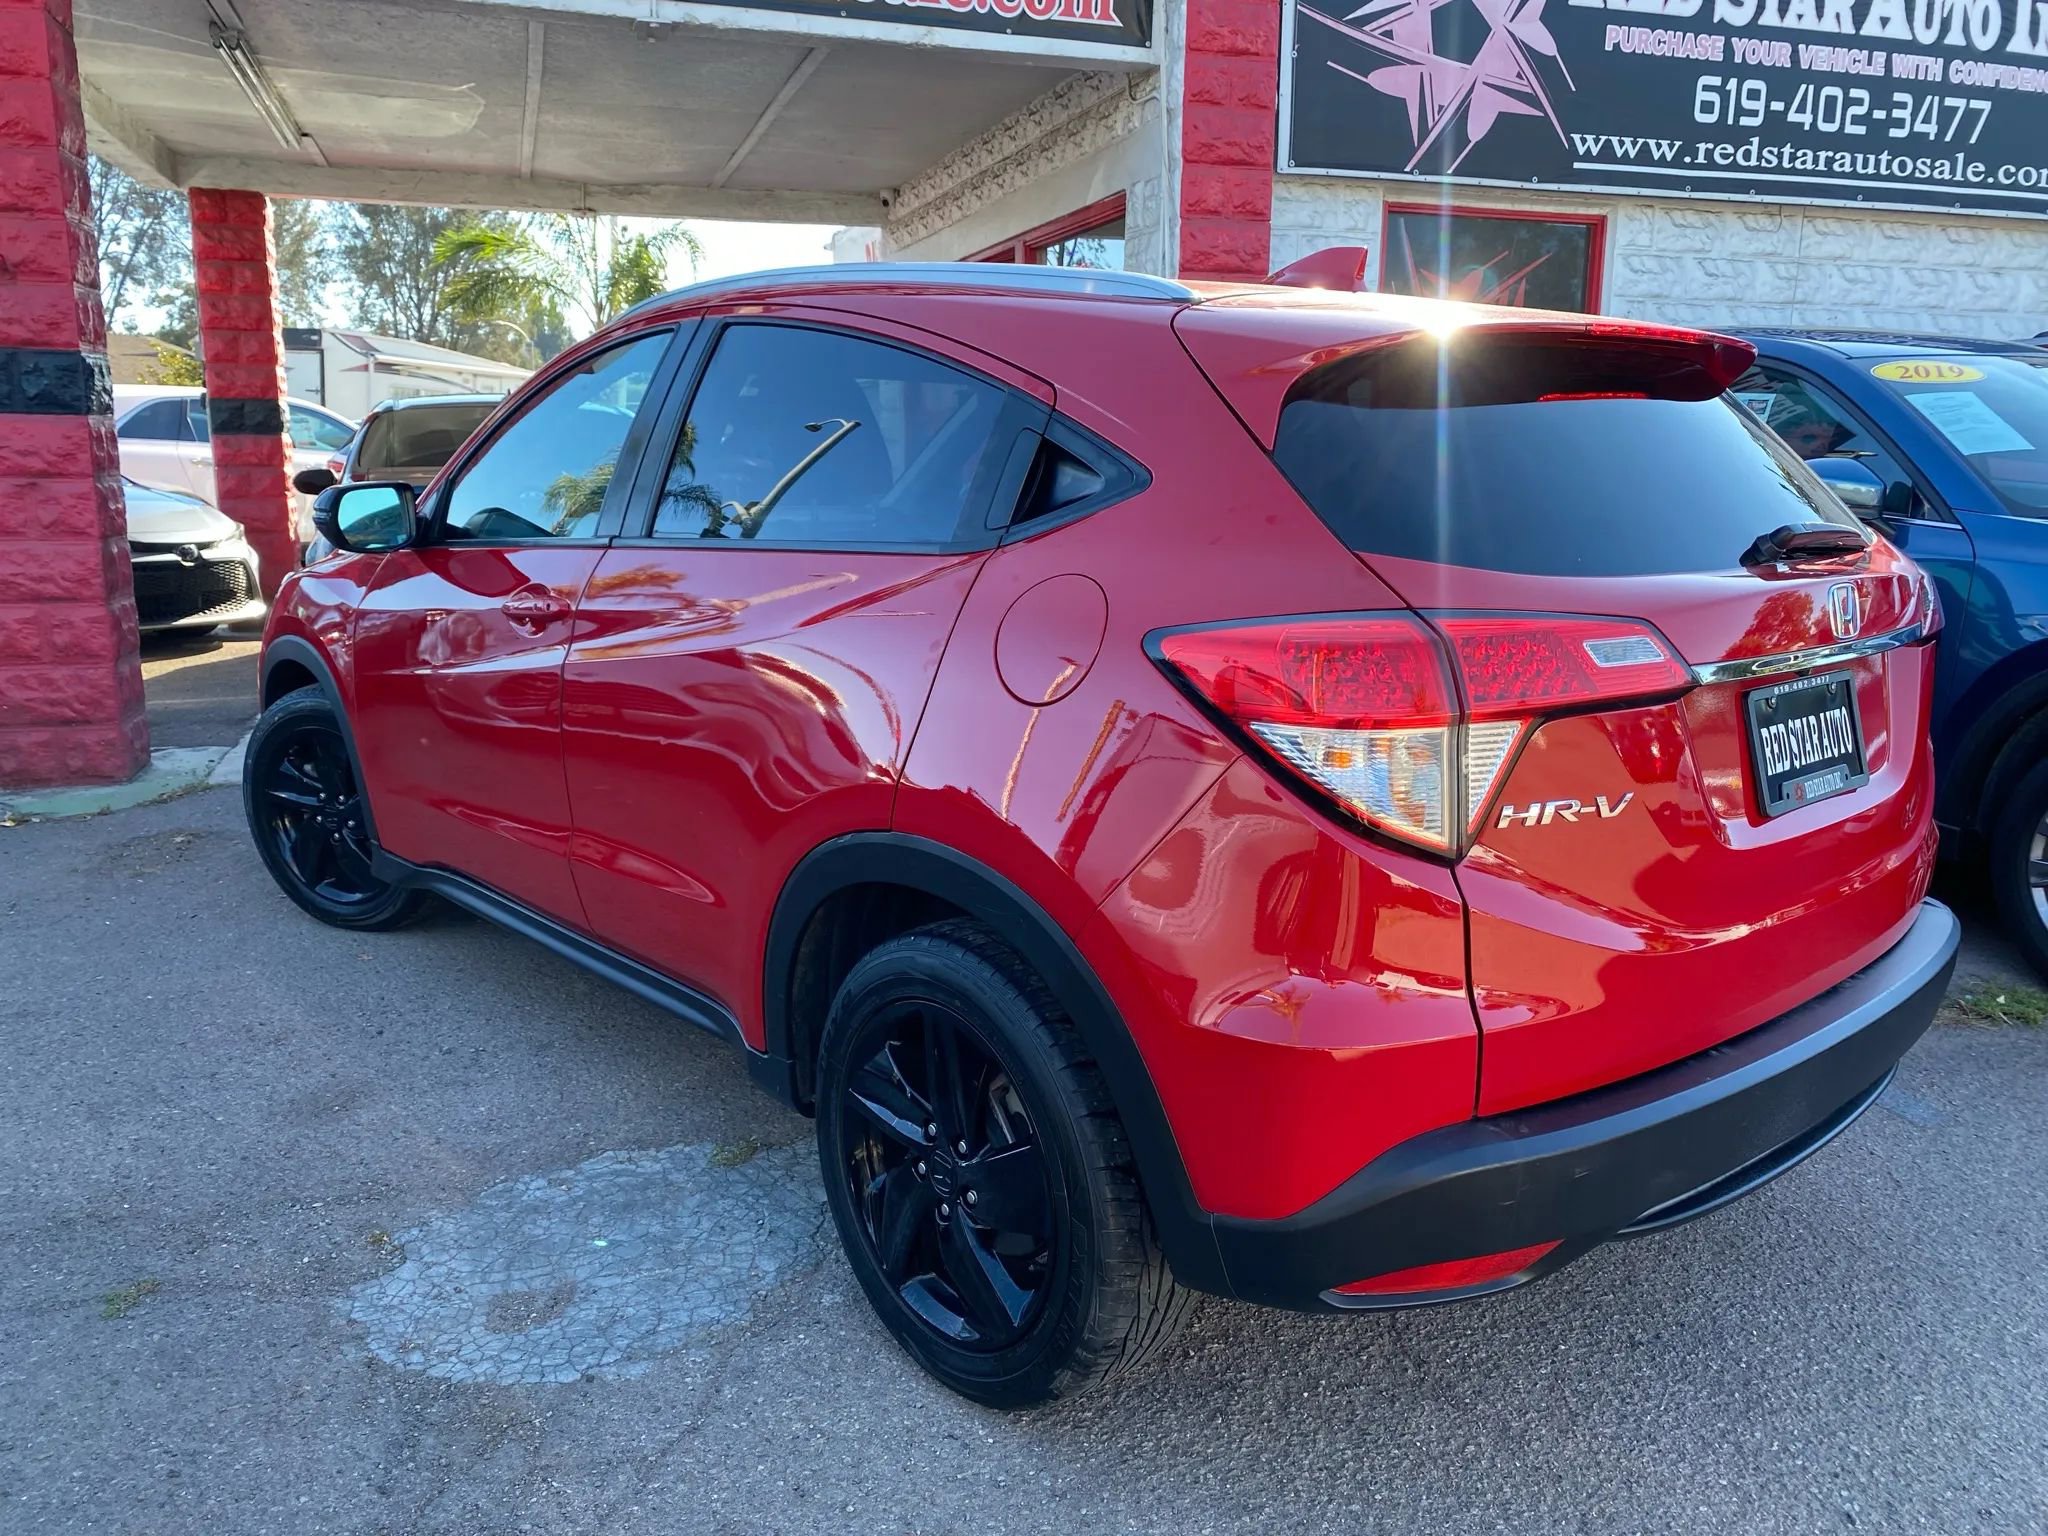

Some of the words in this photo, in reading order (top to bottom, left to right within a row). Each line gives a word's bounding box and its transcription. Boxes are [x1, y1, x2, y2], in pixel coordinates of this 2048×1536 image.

[1859, 0, 2002, 51] AUTO
[1605, 25, 1725, 61] PURCHASE
[1731, 37, 1792, 68] YOUR
[1798, 44, 1887, 76] VEHICLE
[1892, 53, 1944, 82] WITH
[1694, 75, 1992, 144] 619-402-3477
[1895, 365, 1965, 380] 2019
[1761, 723, 1791, 776] RED
[1789, 714, 1823, 770] STAR
[1819, 705, 1853, 759] AUTO
[1497, 792, 1634, 829] HR-V
